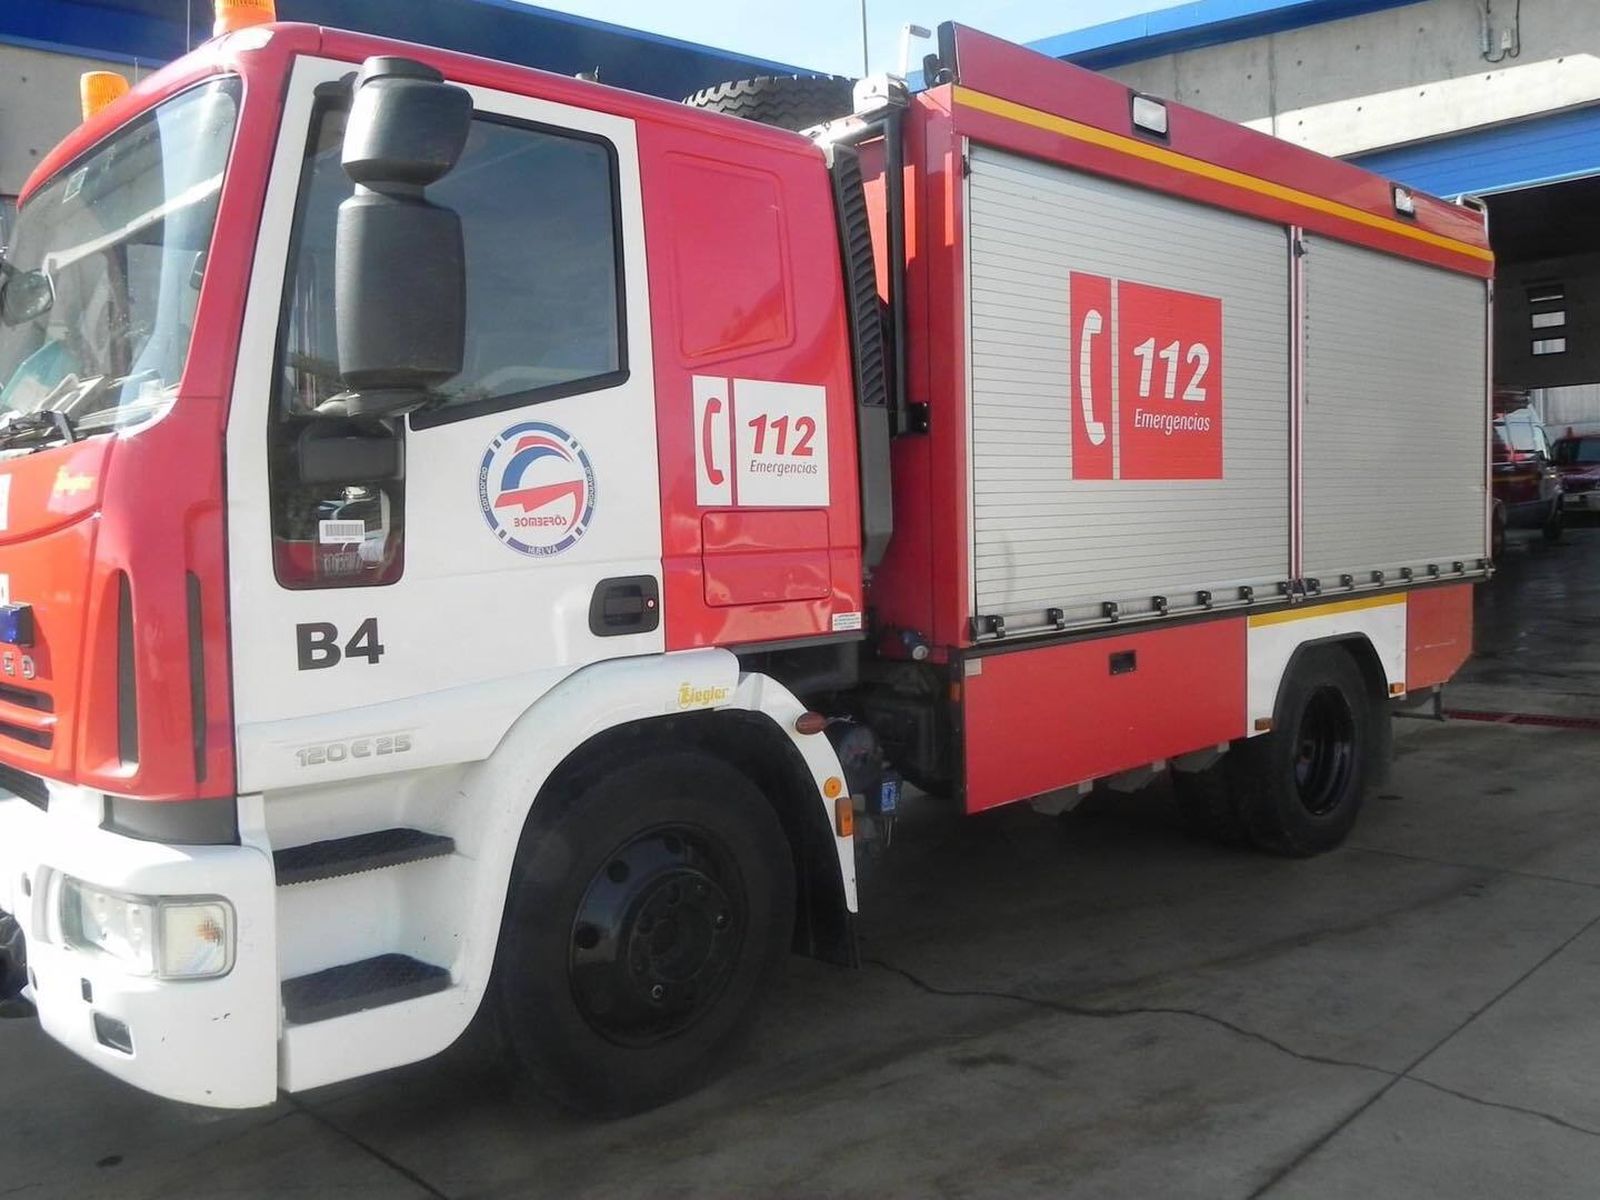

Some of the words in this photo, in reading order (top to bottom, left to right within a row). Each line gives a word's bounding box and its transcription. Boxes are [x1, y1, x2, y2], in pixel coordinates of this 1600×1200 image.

[1134, 337, 1210, 401] 112
[748, 414, 816, 456] 112
[1134, 408, 1211, 436] Emergencias
[750, 459, 818, 477] Emergencias
[296, 617, 385, 671] B4
